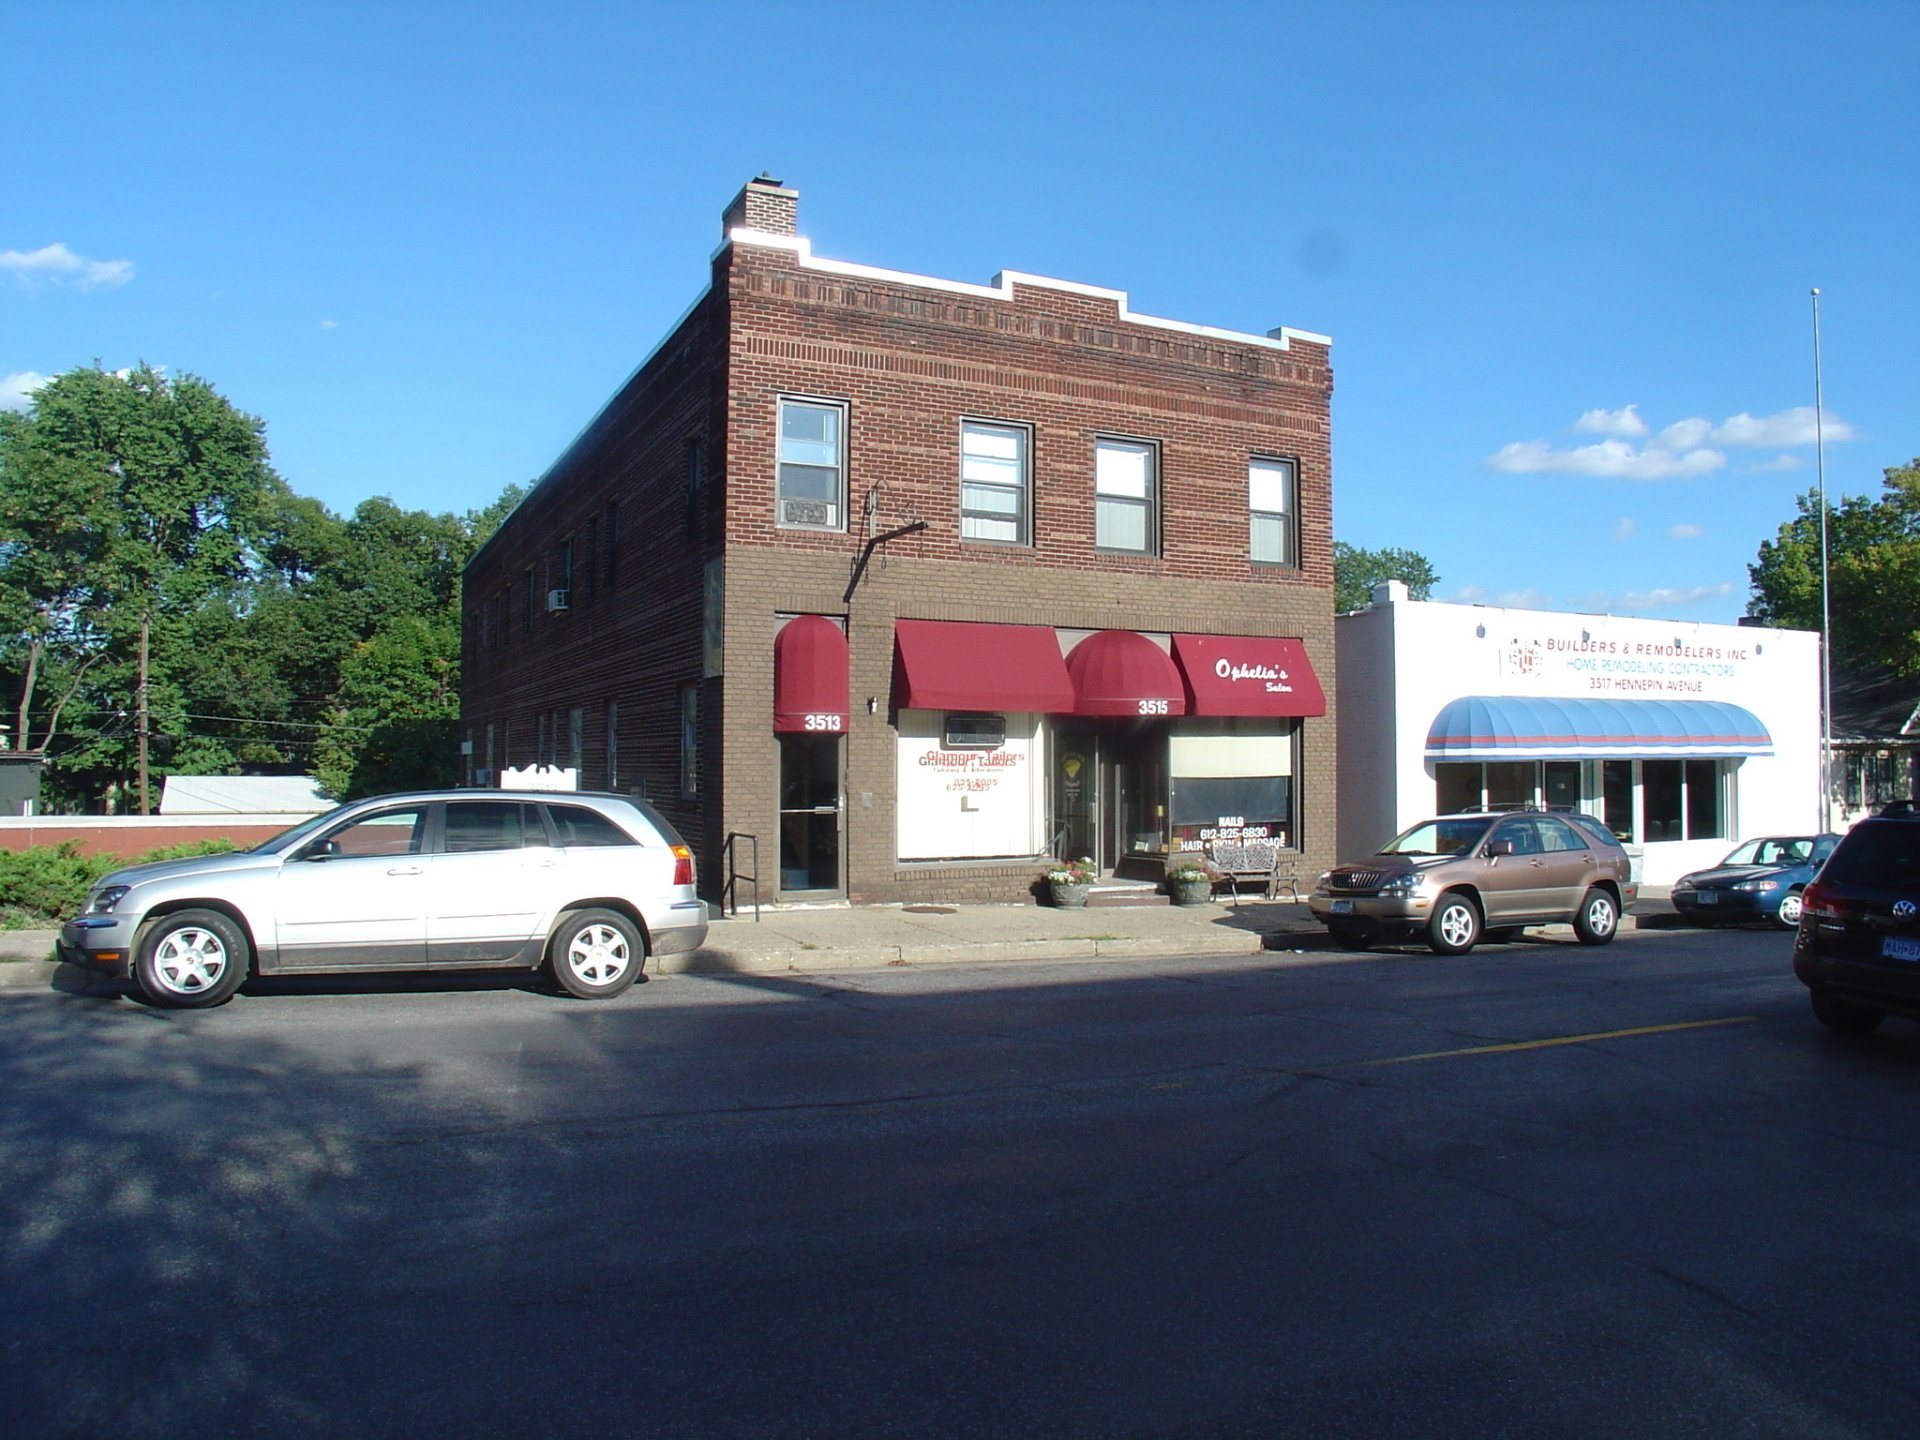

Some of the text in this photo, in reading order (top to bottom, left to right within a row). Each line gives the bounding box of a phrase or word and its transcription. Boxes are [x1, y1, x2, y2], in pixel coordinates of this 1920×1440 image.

[1547, 638, 1616, 653] BUILDERS
[1622, 643, 1630, 655] &
[1636, 643, 1721, 660] REMODELERS
[1215, 658, 1289, 681] Ophelia's
[1567, 658, 1735, 677] HOME REMODELING CONTRACTORS
[1265, 682, 1293, 692] Salon
[1589, 677, 1703, 692] 3517 HENNEPIN AVENUE
[1138, 700, 1168, 715] 3515
[805, 714, 841, 731] 3513
[926, 749, 1025, 761] Glamour Tailors
[1218, 816, 1245, 827] NAILS
[1200, 827, 1268, 840] 612-825-6830
[1181, 840, 1204, 851] HAIR
